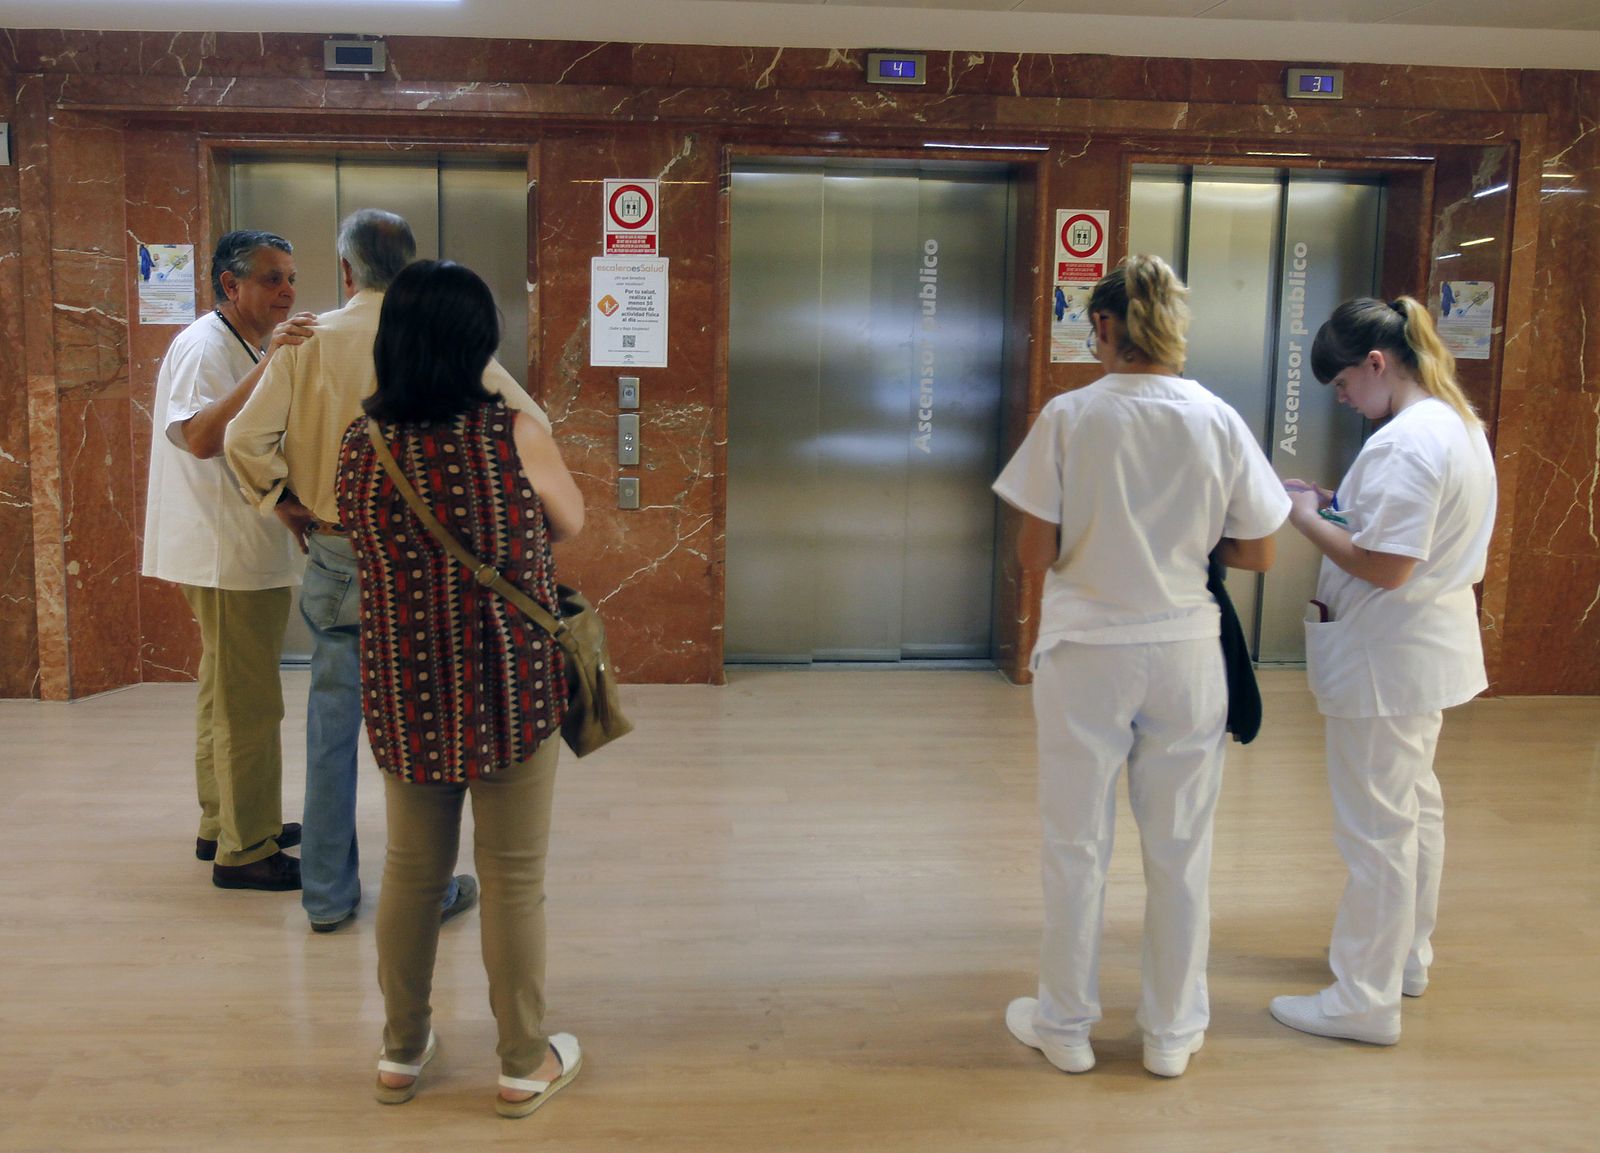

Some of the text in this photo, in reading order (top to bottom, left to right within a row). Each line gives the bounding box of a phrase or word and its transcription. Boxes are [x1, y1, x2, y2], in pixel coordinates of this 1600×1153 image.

[893, 61, 904, 77] 4
[1312, 76, 1322, 92] 3
[915, 338, 936, 454] Ascensor
[1280, 340, 1302, 456] Ascensor
